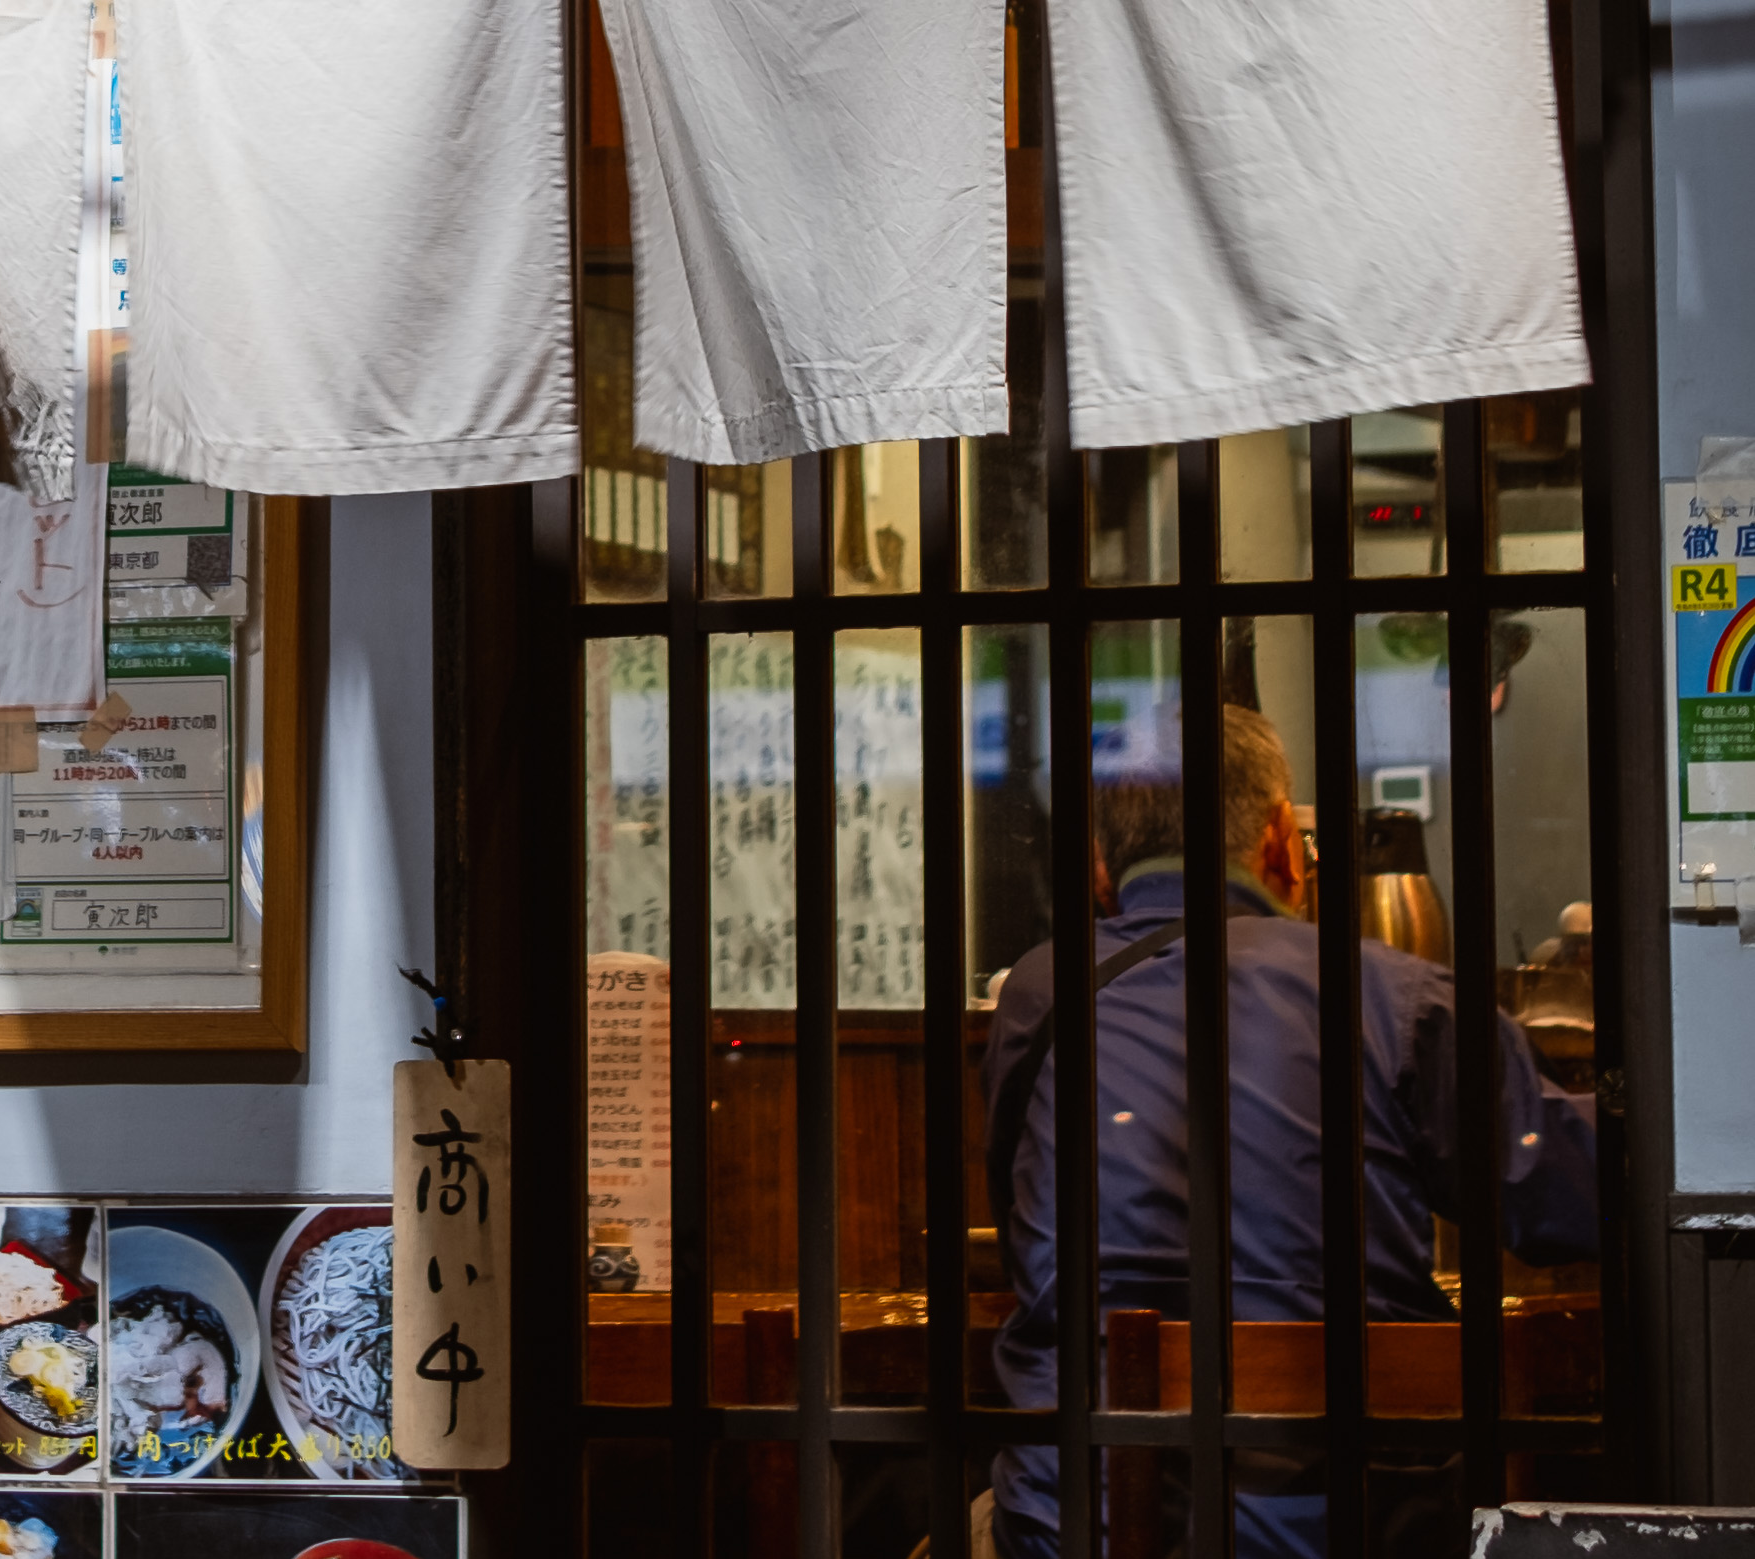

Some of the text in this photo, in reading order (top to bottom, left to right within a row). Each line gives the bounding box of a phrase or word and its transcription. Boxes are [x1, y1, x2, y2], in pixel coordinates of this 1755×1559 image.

[1680, 568, 1729, 602] R4
[92, 846, 144, 860] 4人以内
[412, 1108, 490, 1438] 商い中
[78, 1435, 97, 1458] 円
